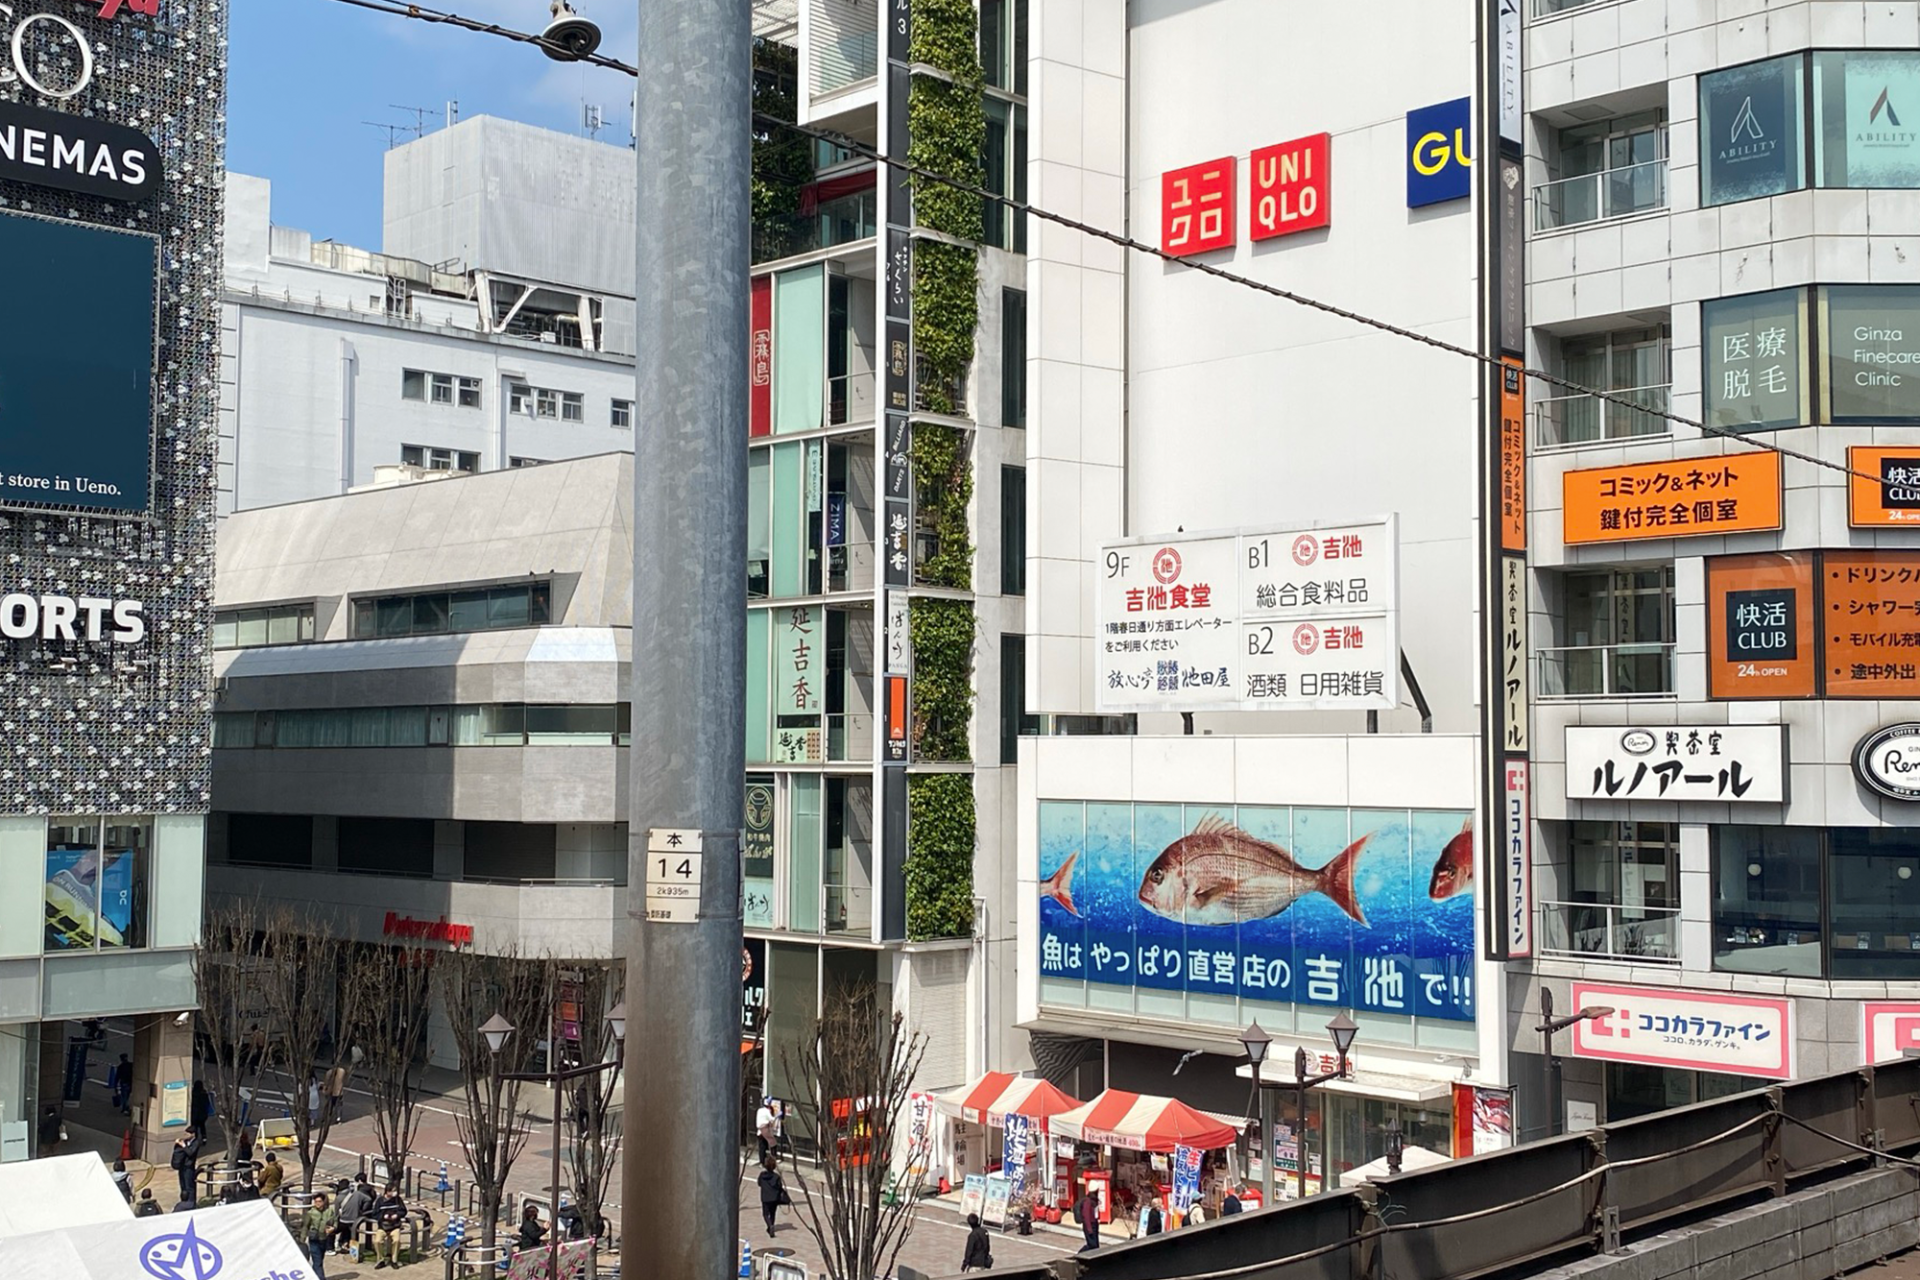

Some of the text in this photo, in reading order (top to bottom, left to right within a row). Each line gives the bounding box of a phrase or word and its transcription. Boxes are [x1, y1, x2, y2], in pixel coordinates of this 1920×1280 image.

[1505, 23, 1514, 114] ABILITY
[1719, 139, 1778, 160] ABILITY
[1856, 132, 1918, 142] ABILITY
[1413, 127, 1471, 176] GU
[1258, 148, 1311, 189] UNI
[1171, 170, 1222, 210] ユニ
[1258, 186, 1317, 231] QLO
[1169, 207, 1222, 247] クロ
[1723, 326, 1787, 364] 医療
[1854, 326, 1903, 341] Ginza
[1854, 349, 1920, 364] Finecare
[1722, 365, 1787, 400] 脱毛
[1855, 371, 1901, 386] Clinic
[8, 474, 122, 496] store in Ueno.
[1599, 466, 1739, 497] コミック&ネット
[831, 503, 840, 541] ZIMA
[1600, 498, 1739, 531] 鍵付完全個室
[1248, 539, 1268, 569] B1
[1322, 534, 1363, 560] 吉池
[1106, 551, 1130, 579] 9F
[1125, 582, 1211, 613] 吉池食堂
[1256, 578, 1369, 609] 総合食料品
[0, 593, 144, 644] ORTS
[1736, 602, 1787, 628] 快活
[1849, 600, 1920, 616] シャワー
[1105, 616, 1233, 635] 1階春日通り方面エレベーター
[1323, 625, 1364, 650] 吉池
[1105, 638, 1180, 653] をご利用ください
[1248, 626, 1274, 655] B2
[1738, 631, 1787, 650] CLUB
[790, 607, 812, 710] 延吉香
[1761, 667, 1788, 677] OPEN
[1851, 663, 1916, 680] 途中外出
[1181, 666, 1231, 689] 池田屋
[1247, 670, 1384, 698] 酒類 日用雑貨
[1665, 729, 1723, 756] 喫茶室
[1592, 758, 1754, 799] ルノアール
[666, 832, 682, 848] 本
[658, 858, 693, 879] 14
[1511, 799, 1524, 945] ココカラファイン
[656, 886, 689, 896] 2k935m
[1638, 1014, 1771, 1042] ココカラファイン
[912, 1099, 928, 1136] 甘酒
[954, 1122, 967, 1166] 駐輪場
[1181, 1148, 1201, 1210] 生ビール
